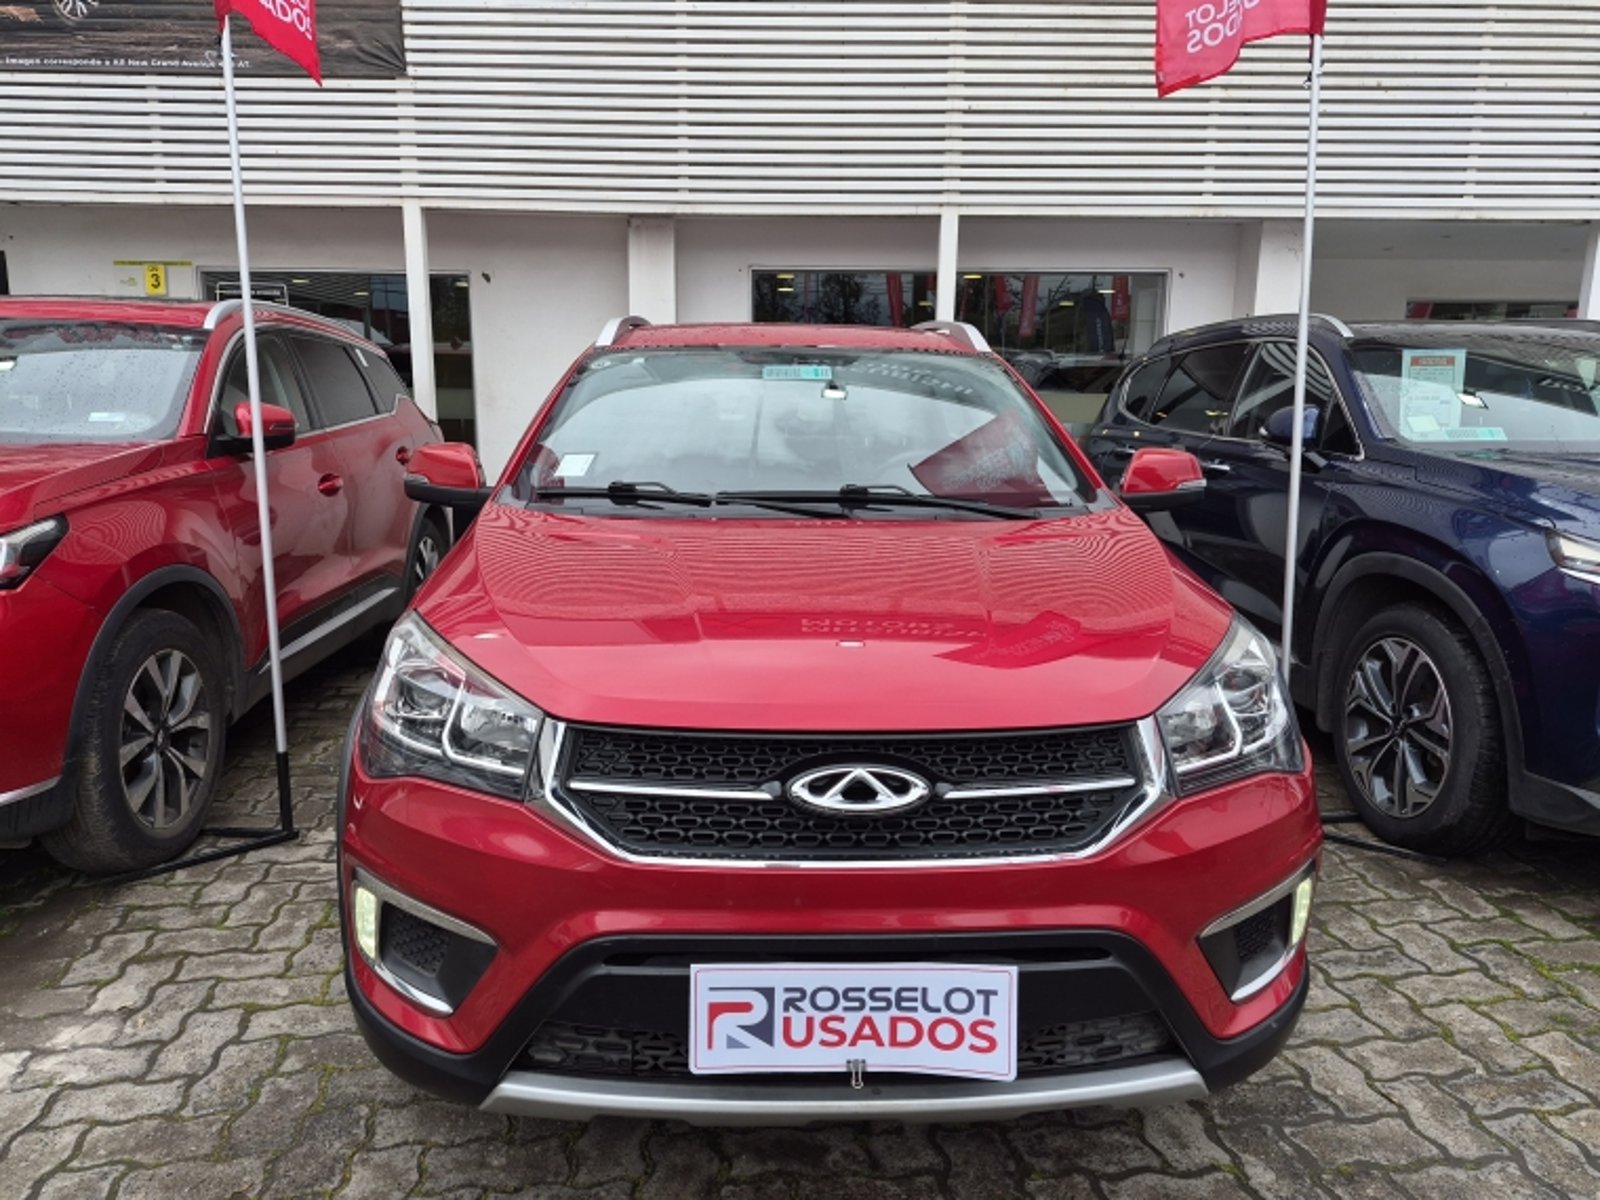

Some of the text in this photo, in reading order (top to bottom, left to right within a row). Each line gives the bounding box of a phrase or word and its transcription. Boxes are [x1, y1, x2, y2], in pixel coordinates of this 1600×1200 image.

[5, 56, 41, 66] Imagen
[43, 57, 102, 67] corresponde
[151, 273, 161, 289] 3
[783, 986, 999, 1016] ROSSELOT
[783, 1016, 998, 1054] USADOS
